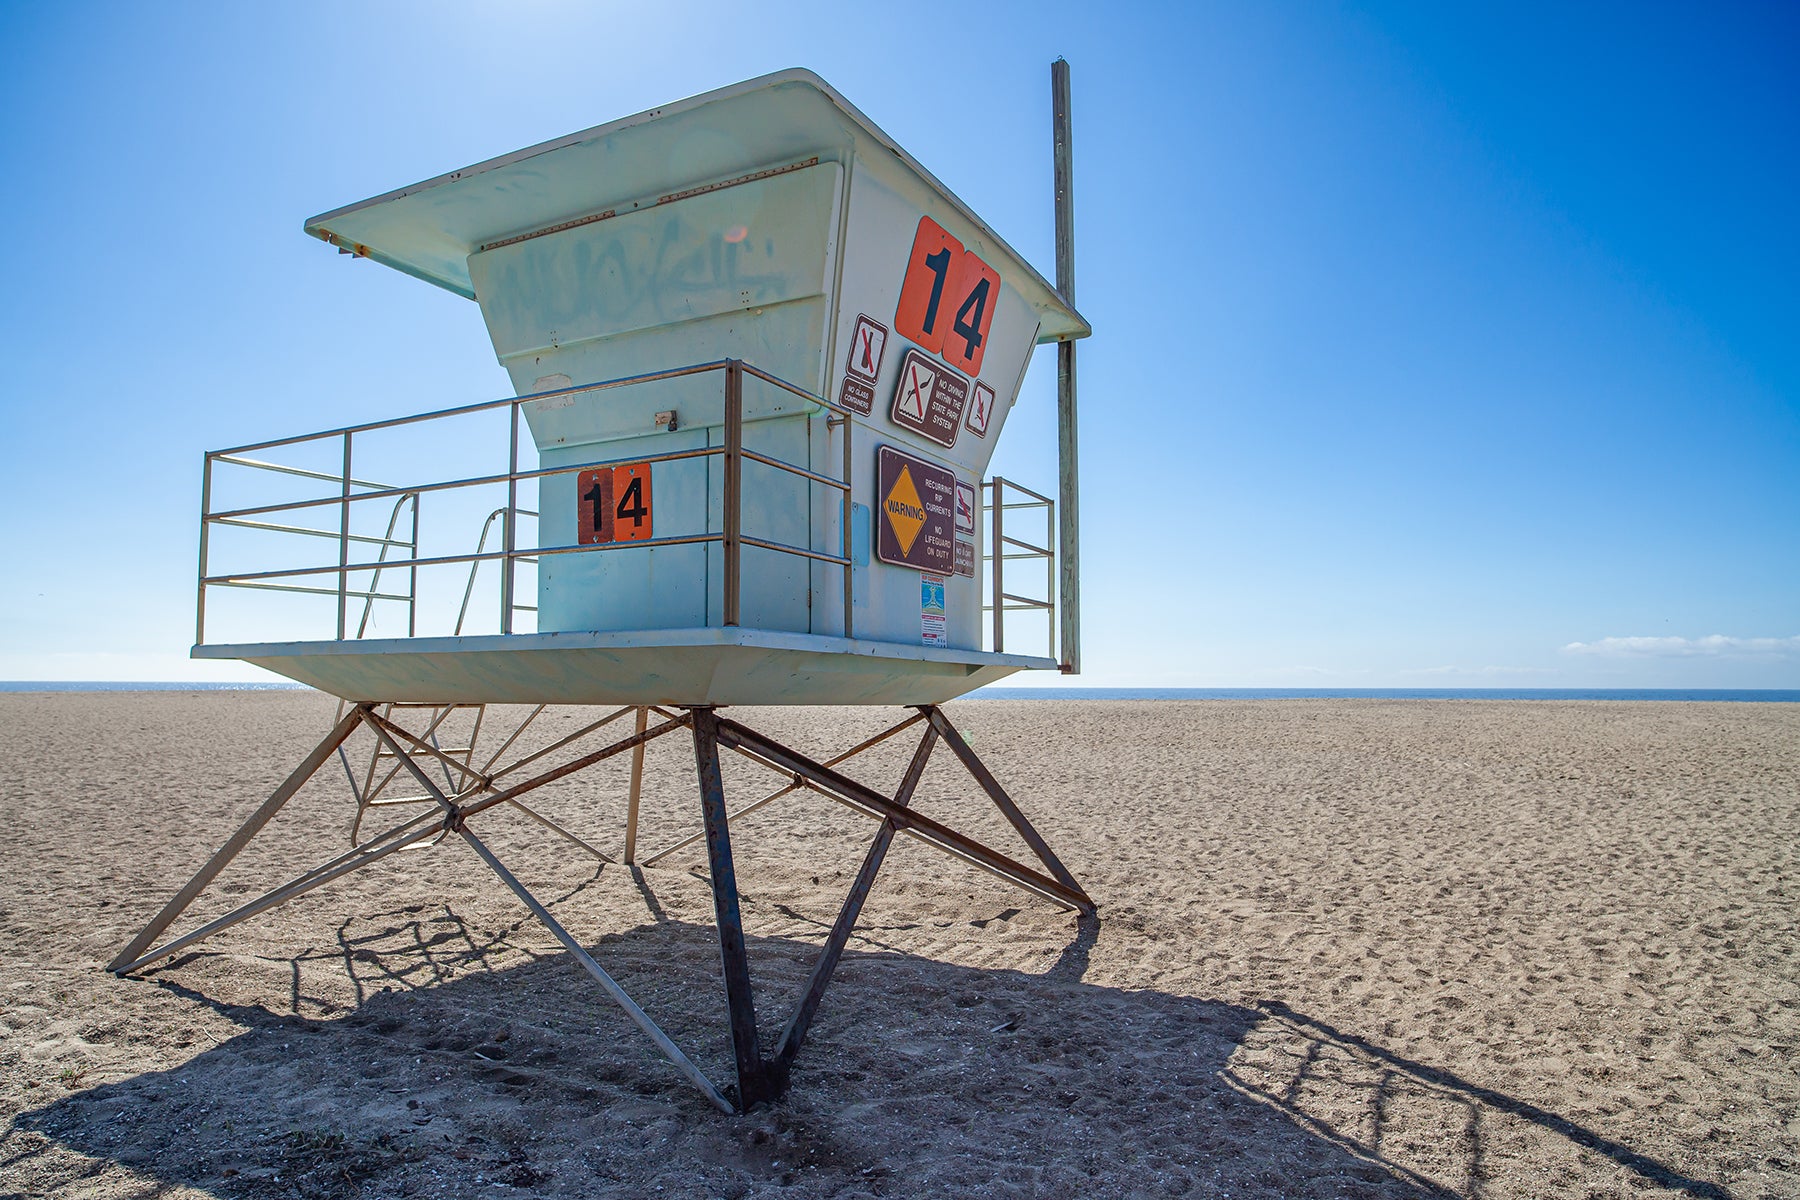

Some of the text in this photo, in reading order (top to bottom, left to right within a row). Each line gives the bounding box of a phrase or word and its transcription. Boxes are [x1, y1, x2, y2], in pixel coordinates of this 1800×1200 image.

[922, 247, 991, 361] 14
[848, 385, 869, 399] NO GLASS
[938, 379, 964, 399] NO DIVING
[844, 393, 869, 409] CONTAINERS
[935, 390, 962, 410] WITHIN THE
[931, 401, 959, 421] STATE PARK
[932, 415, 952, 430] SYSTEM
[925, 478, 952, 495] RECURRING
[583, 476, 648, 532] 14
[935, 494, 943, 503] RIP
[888, 500, 923, 520] WARNING
[926, 502, 951, 518] CURRENTS
[935, 526, 942, 535] NO
[925, 535, 951, 548] LIFEGUARD
[927, 547, 949, 559] ON DUTY
